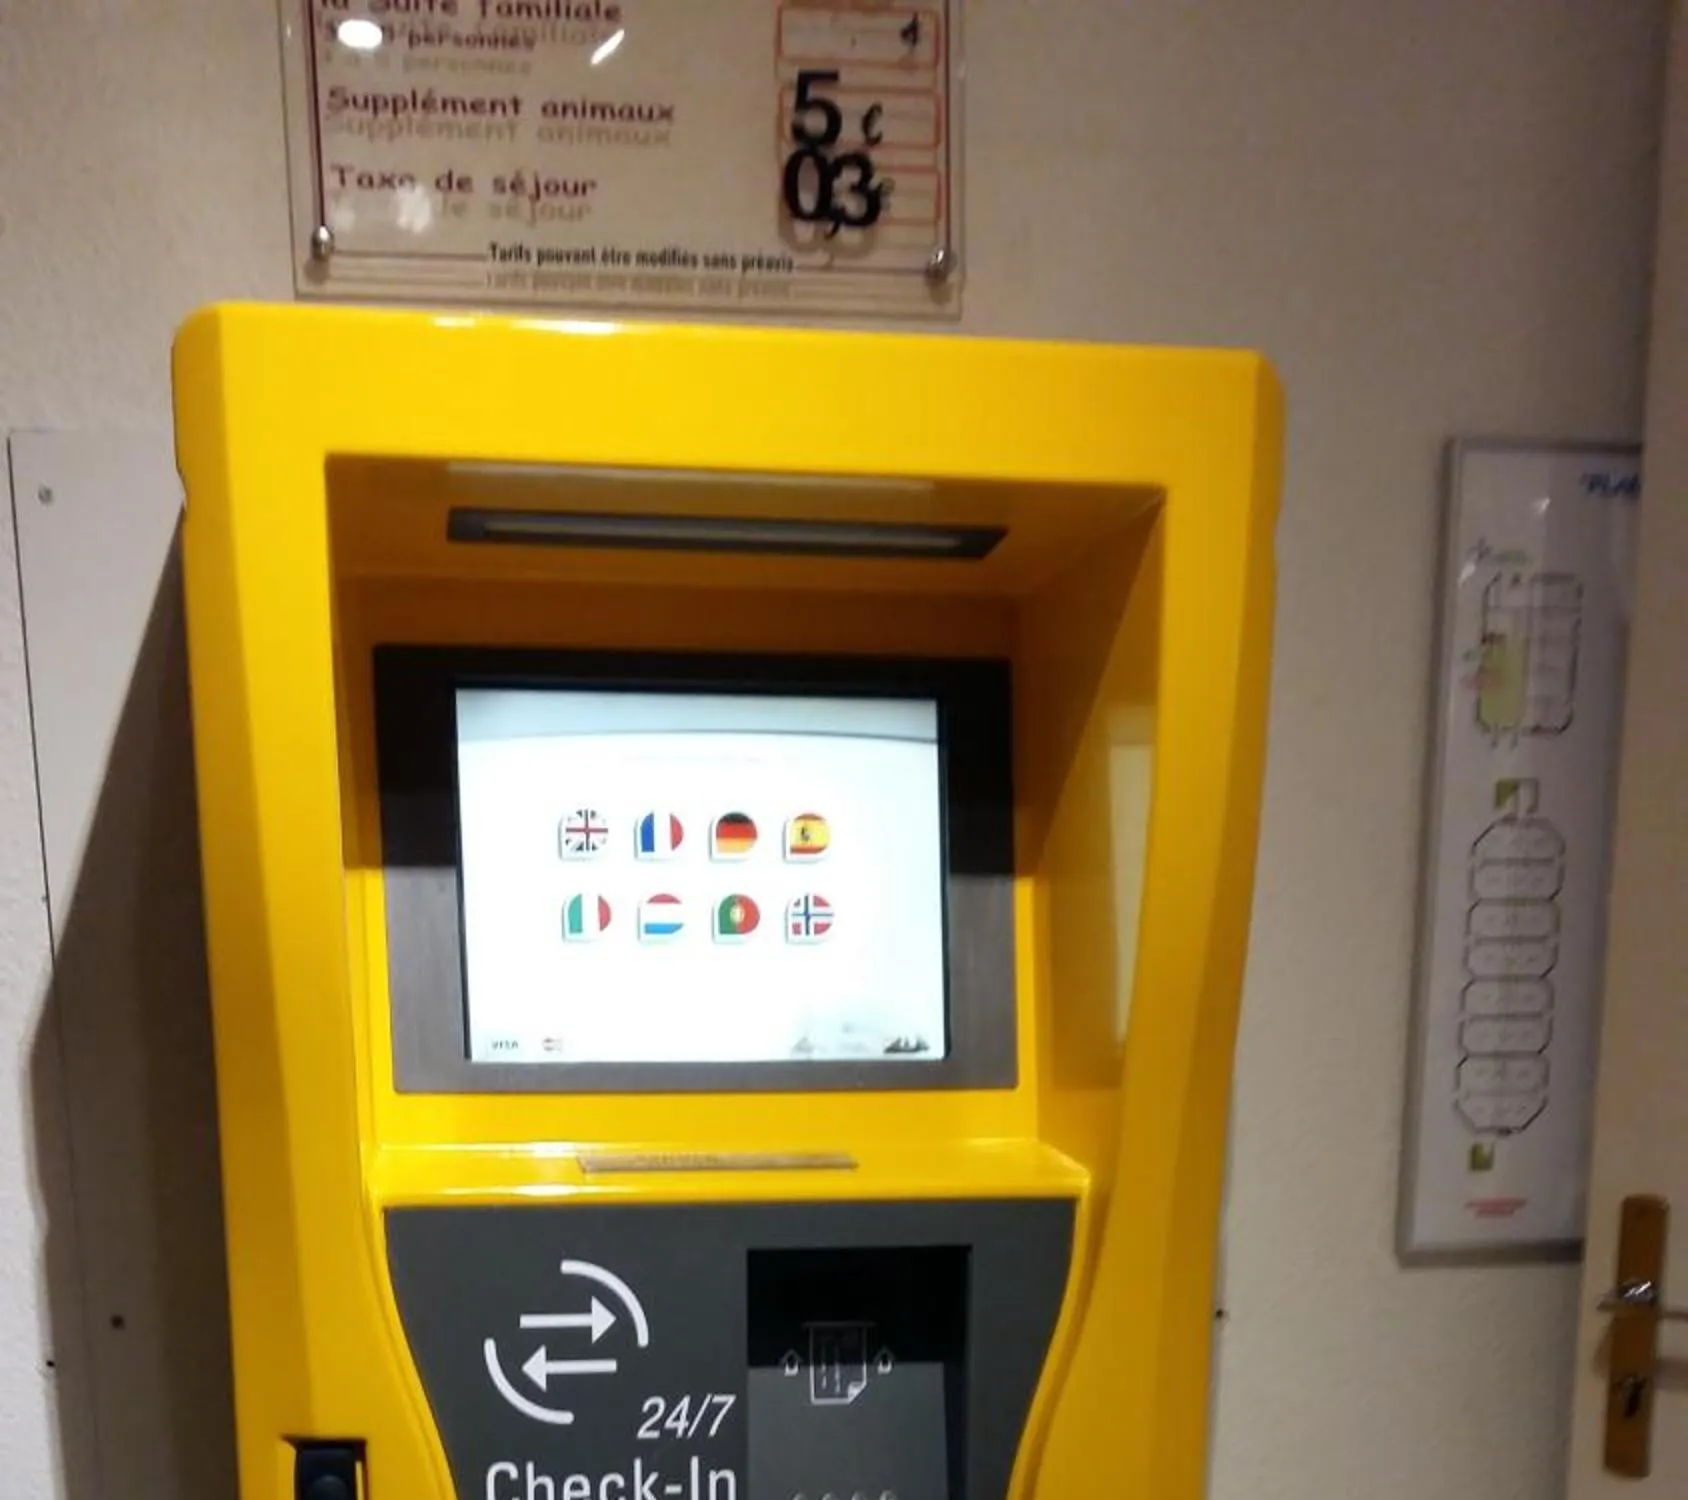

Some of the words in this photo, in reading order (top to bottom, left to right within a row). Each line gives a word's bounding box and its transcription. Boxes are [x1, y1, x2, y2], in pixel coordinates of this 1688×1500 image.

[408, 28, 535, 49] personnes
[328, 85, 522, 119] Supplément
[540, 98, 675, 123] animaux
[791, 69, 842, 148] 5
[330, 162, 418, 191] Taxe
[434, 170, 474, 193] de
[492, 171, 597, 201] séjour
[636, 1393, 737, 1439] 24/7
